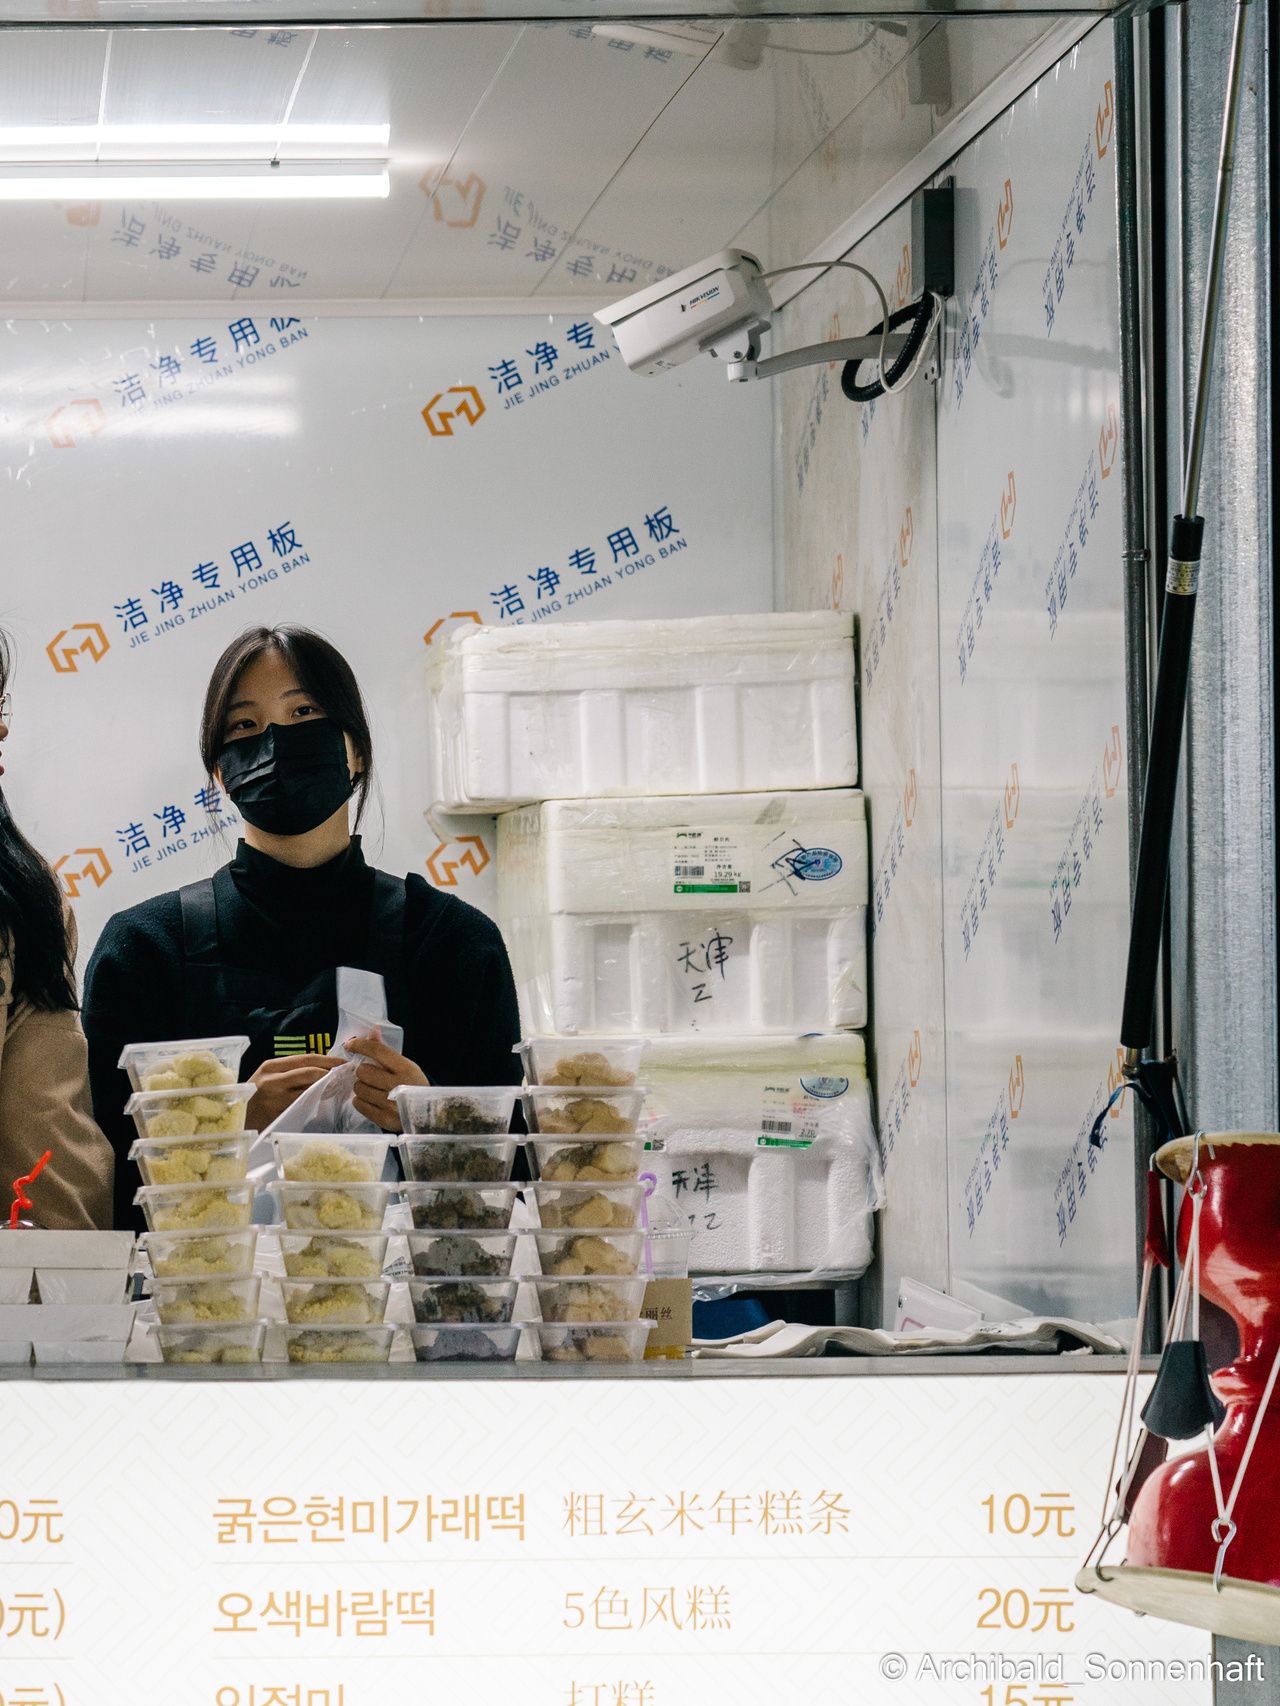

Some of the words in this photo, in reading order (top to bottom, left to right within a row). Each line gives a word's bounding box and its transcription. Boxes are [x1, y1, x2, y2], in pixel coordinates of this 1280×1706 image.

[237, 344, 276, 368] YONG
[280, 328, 308, 349] BAN
[488, 321, 596, 393] 洁净专
[504, 391, 523, 409] JIE
[528, 375, 559, 397] JING
[563, 351, 609, 381] ZHUAN
[113, 522, 303, 632] 洁净专用板
[489, 507, 679, 617] 洁净专用板
[530, 599, 561, 621] JING
[565, 575, 611, 605] ZHUAN
[615, 555, 654, 579] YONG
[658, 539, 686, 560] BAN
[130, 630, 149, 648] JIE
[154, 614, 185, 636] JING
[189, 590, 235, 620] ZHUAN
[239, 570, 278, 594] YONG
[282, 554, 310, 575] BAN
[116, 787, 222, 857] 洁净专
[132, 854, 151, 872] JIE
[156, 838, 187, 860] JING
[191, 814, 237, 844] ZHUAN
[677, 928, 733, 980] 天津
[672, 1163, 719, 1203] 天津
[213, 1493, 526, 1544] 굵은현미가래떡
[562, 1489, 852, 1537] 粗玄米年糕条
[981, 1493, 1076, 1538] 10元
[213, 1588, 436, 1637] 오색바람떡
[563, 1584, 732, 1632] 5色风糕
[976, 1587, 1076, 1632] 20元
